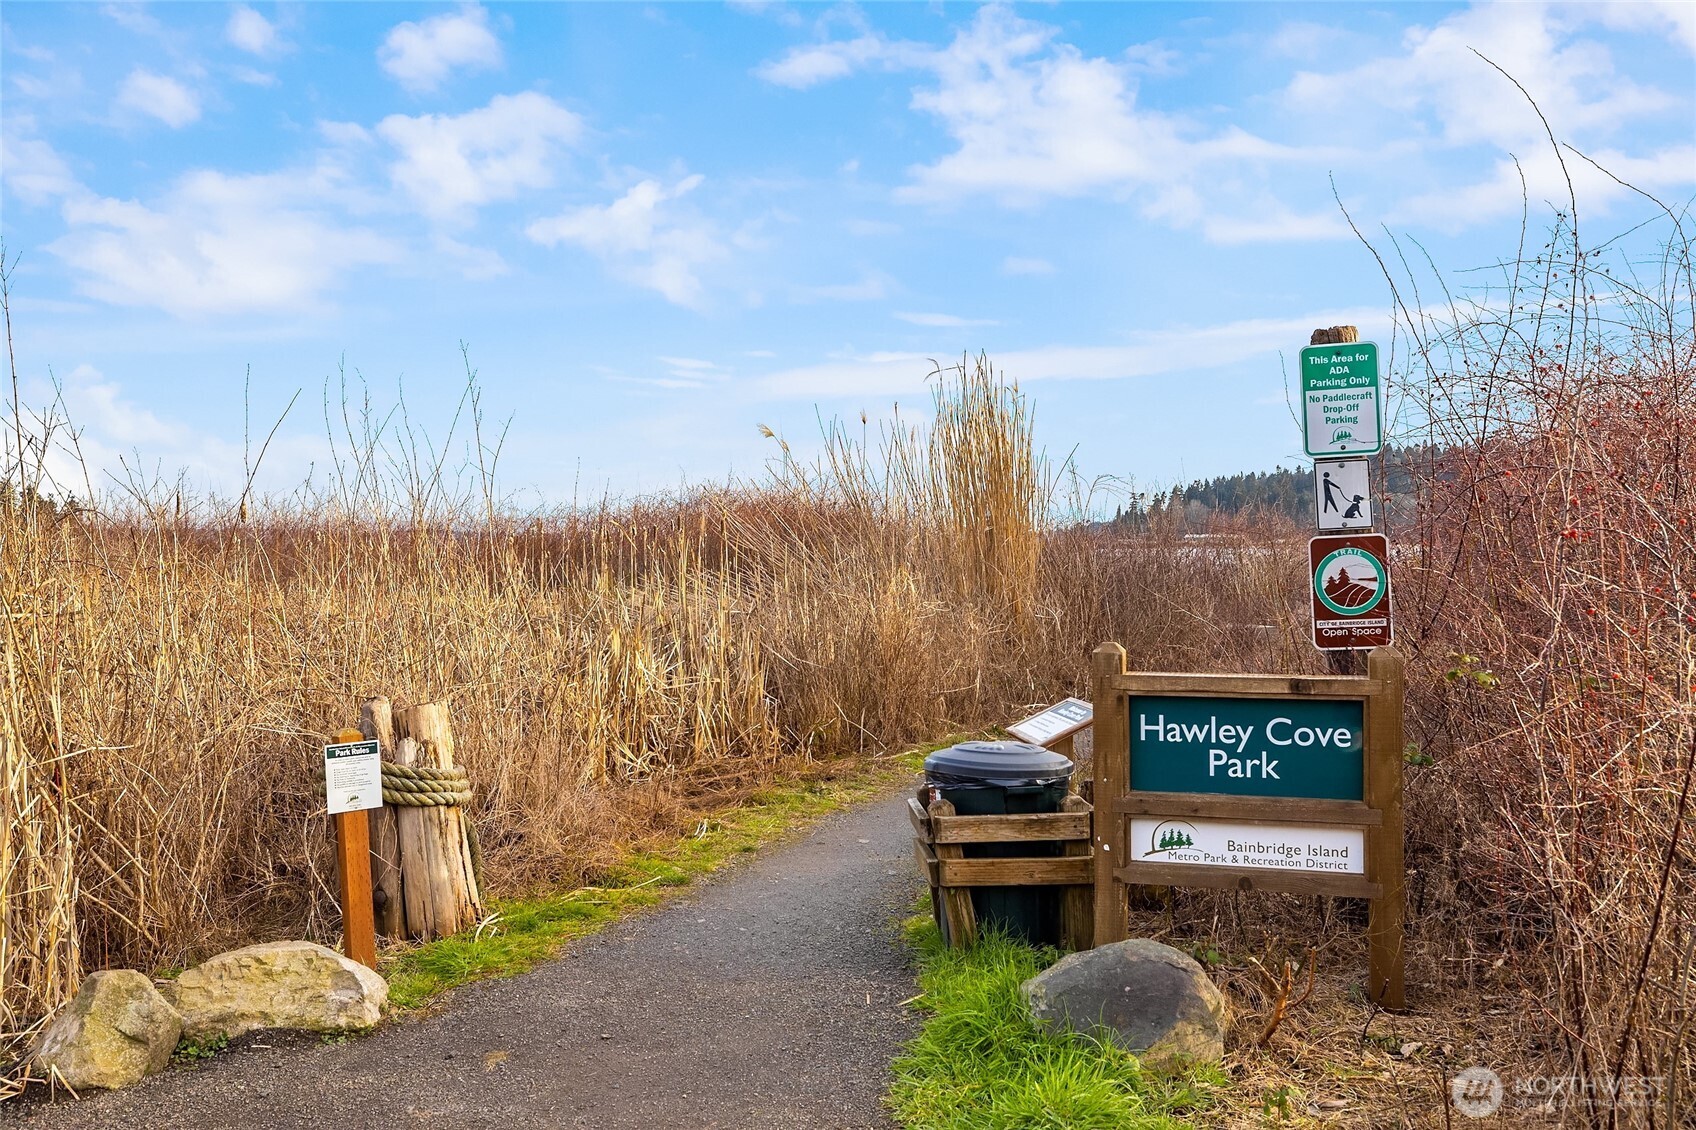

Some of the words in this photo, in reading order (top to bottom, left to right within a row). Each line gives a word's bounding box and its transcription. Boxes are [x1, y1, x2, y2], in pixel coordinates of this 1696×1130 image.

[1309, 355, 1328, 365] This
[1331, 354, 1353, 363] Area
[1355, 353, 1369, 361] for
[1329, 366, 1349, 375] ADA
[1310, 377, 1347, 387] Parking
[1349, 376, 1370, 386] Only
[1309, 395, 1320, 403] No
[1322, 391, 1373, 402] Paddlecraft
[1323, 403, 1359, 414] Drop-Off
[1325, 416, 1358, 425] Parking
[1334, 548, 1362, 557] TRAIL
[1322, 628, 1348, 637] Open
[1351, 627, 1382, 636] Space
[1140, 714, 1254, 752] Hawley
[1265, 717, 1352, 748] Cove
[335, 749, 351, 757] Park
[352, 747, 369, 755] Rules
[1209, 749, 1280, 779] Park
[1227, 840, 1301, 856] Bainbridge
[1307, 844, 1348, 858] Island
[1168, 851, 1199, 862] Metro
[1204, 853, 1227, 863] Park
[1232, 855, 1239, 863] &
[1243, 855, 1301, 868] Recreation
[1306, 858, 1348, 870] District
